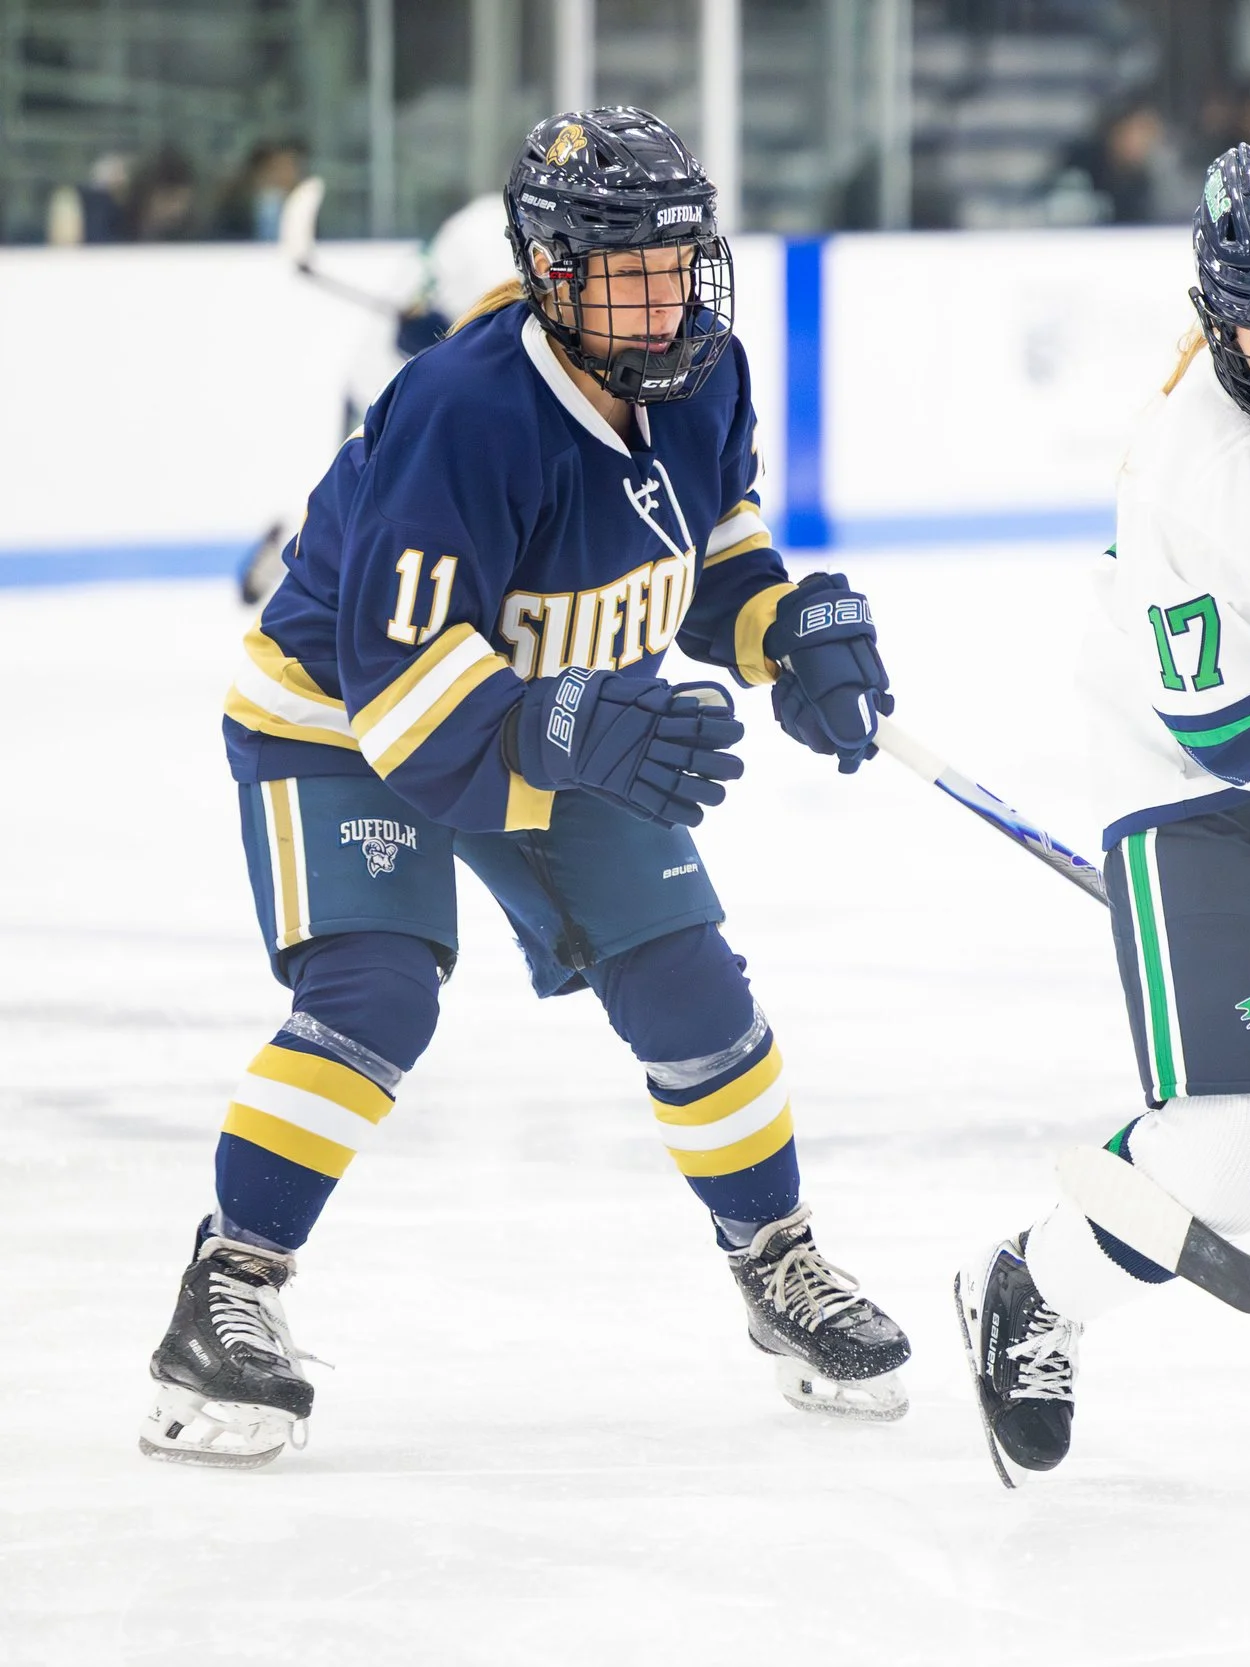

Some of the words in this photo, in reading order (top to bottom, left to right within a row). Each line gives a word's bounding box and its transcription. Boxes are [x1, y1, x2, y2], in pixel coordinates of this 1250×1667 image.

[520, 191, 557, 212] BAUER
[656, 204, 704, 228] SUFFOLK
[641, 372, 688, 389] CCM
[387, 547, 459, 646] 11
[499, 546, 697, 682] SUFFO
[795, 598, 874, 638] BAU
[1147, 592, 1225, 693] 17
[546, 666, 597, 757] BAU
[339, 818, 418, 850] SUFFOLK
[662, 862, 700, 880] BAUER
[987, 1311, 1001, 1377] BAUER
